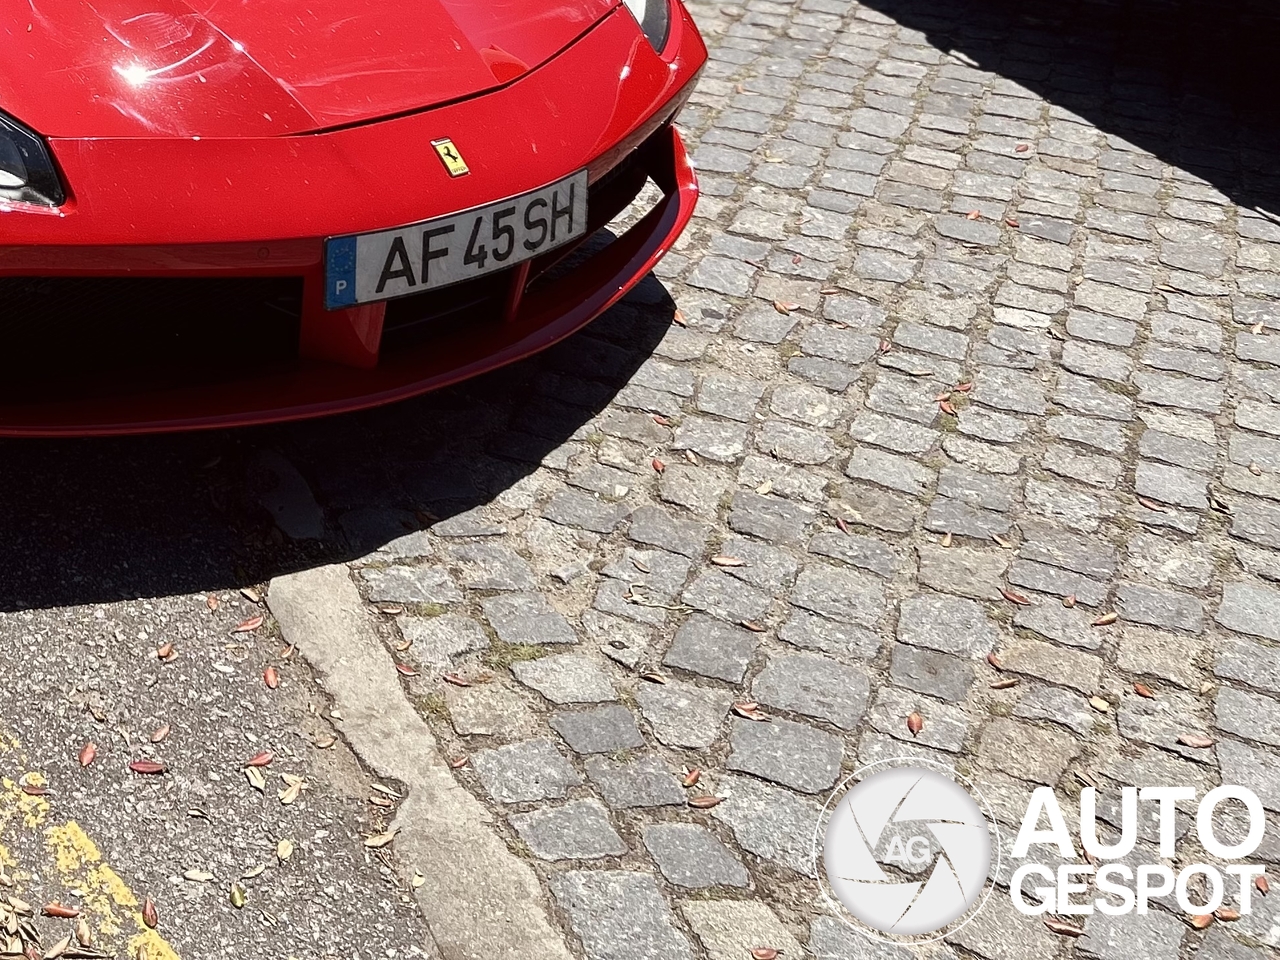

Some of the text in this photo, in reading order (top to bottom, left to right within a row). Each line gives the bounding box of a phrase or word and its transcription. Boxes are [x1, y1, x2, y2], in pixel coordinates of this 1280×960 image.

[375, 182, 576, 293] AF 45 SH
[336, 279, 347, 295] P
